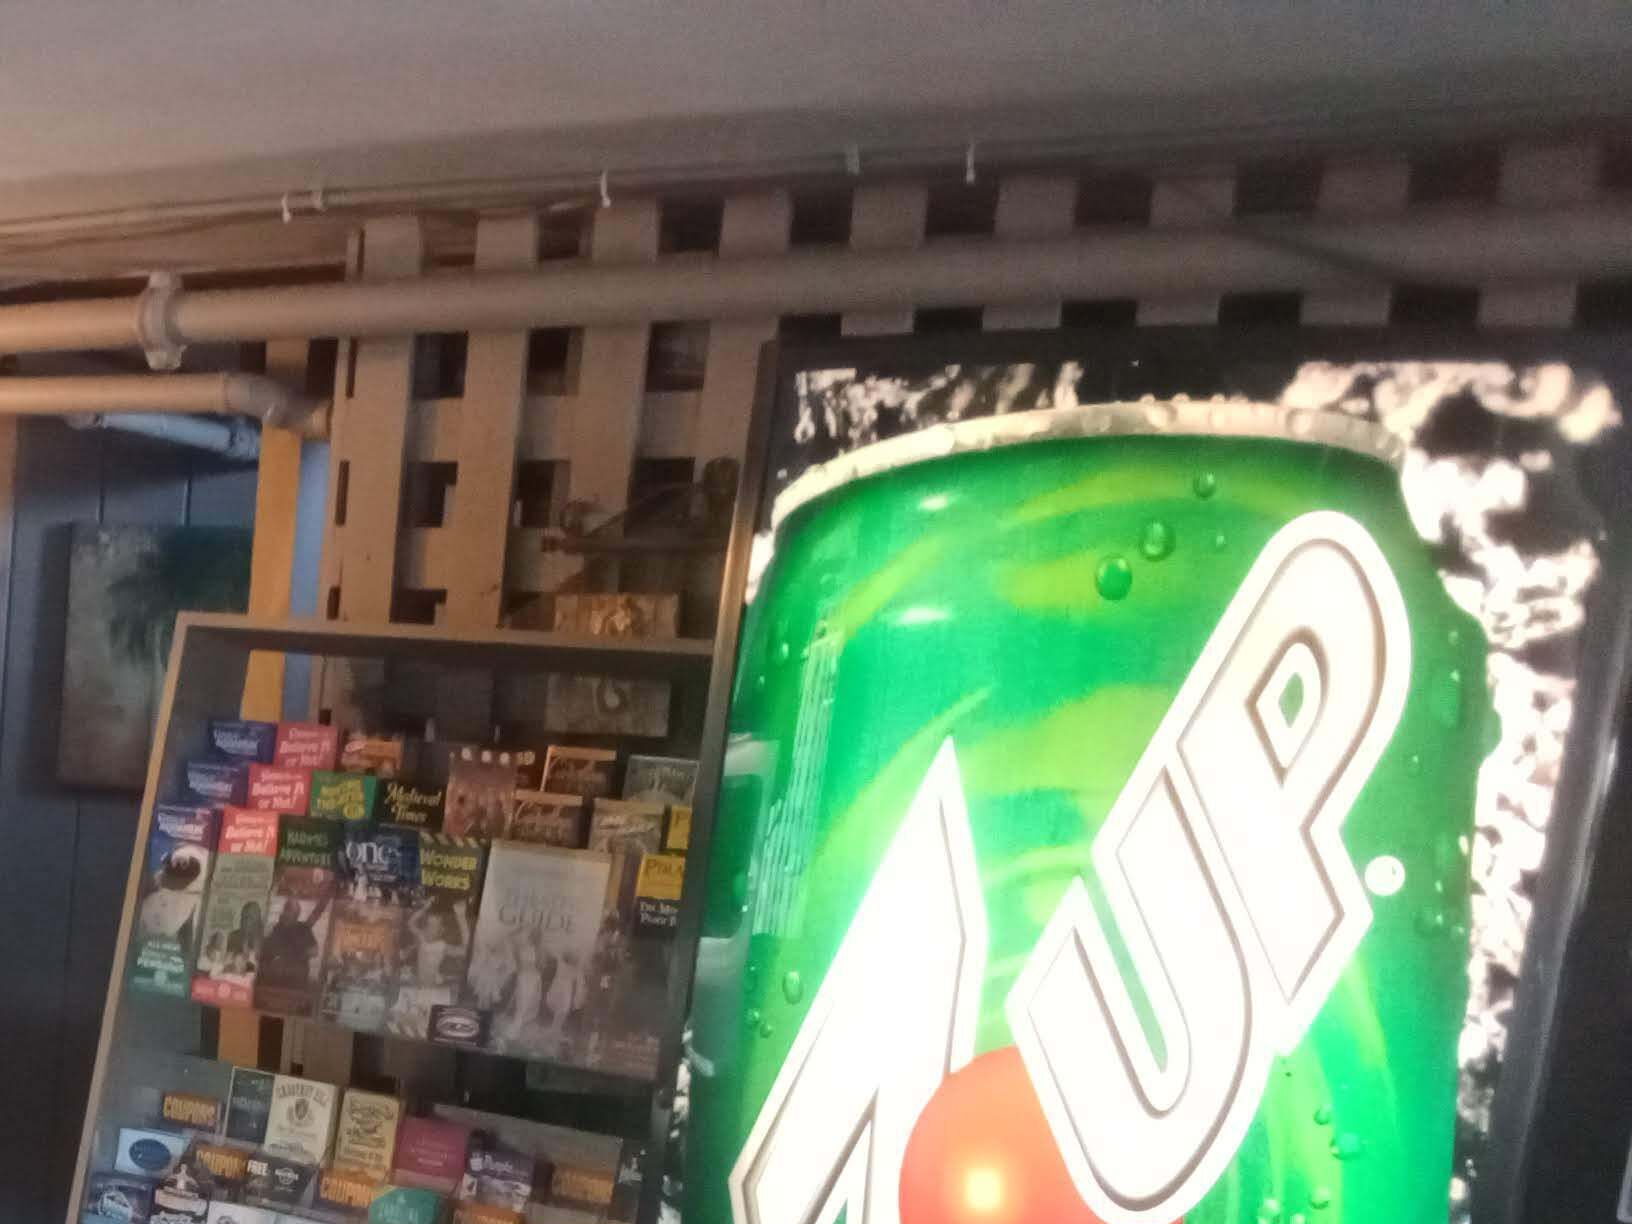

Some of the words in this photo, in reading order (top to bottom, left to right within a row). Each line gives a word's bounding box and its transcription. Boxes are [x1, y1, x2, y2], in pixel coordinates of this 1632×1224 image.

[252, 782, 291, 797] Believe
[384, 782, 442, 807] Medieval
[258, 799, 271, 810] or
[391, 803, 429, 825] Times
[421, 848, 478, 871] WONDER
[422, 868, 472, 891] WORKS
[247, 1159, 269, 1177] FREE
